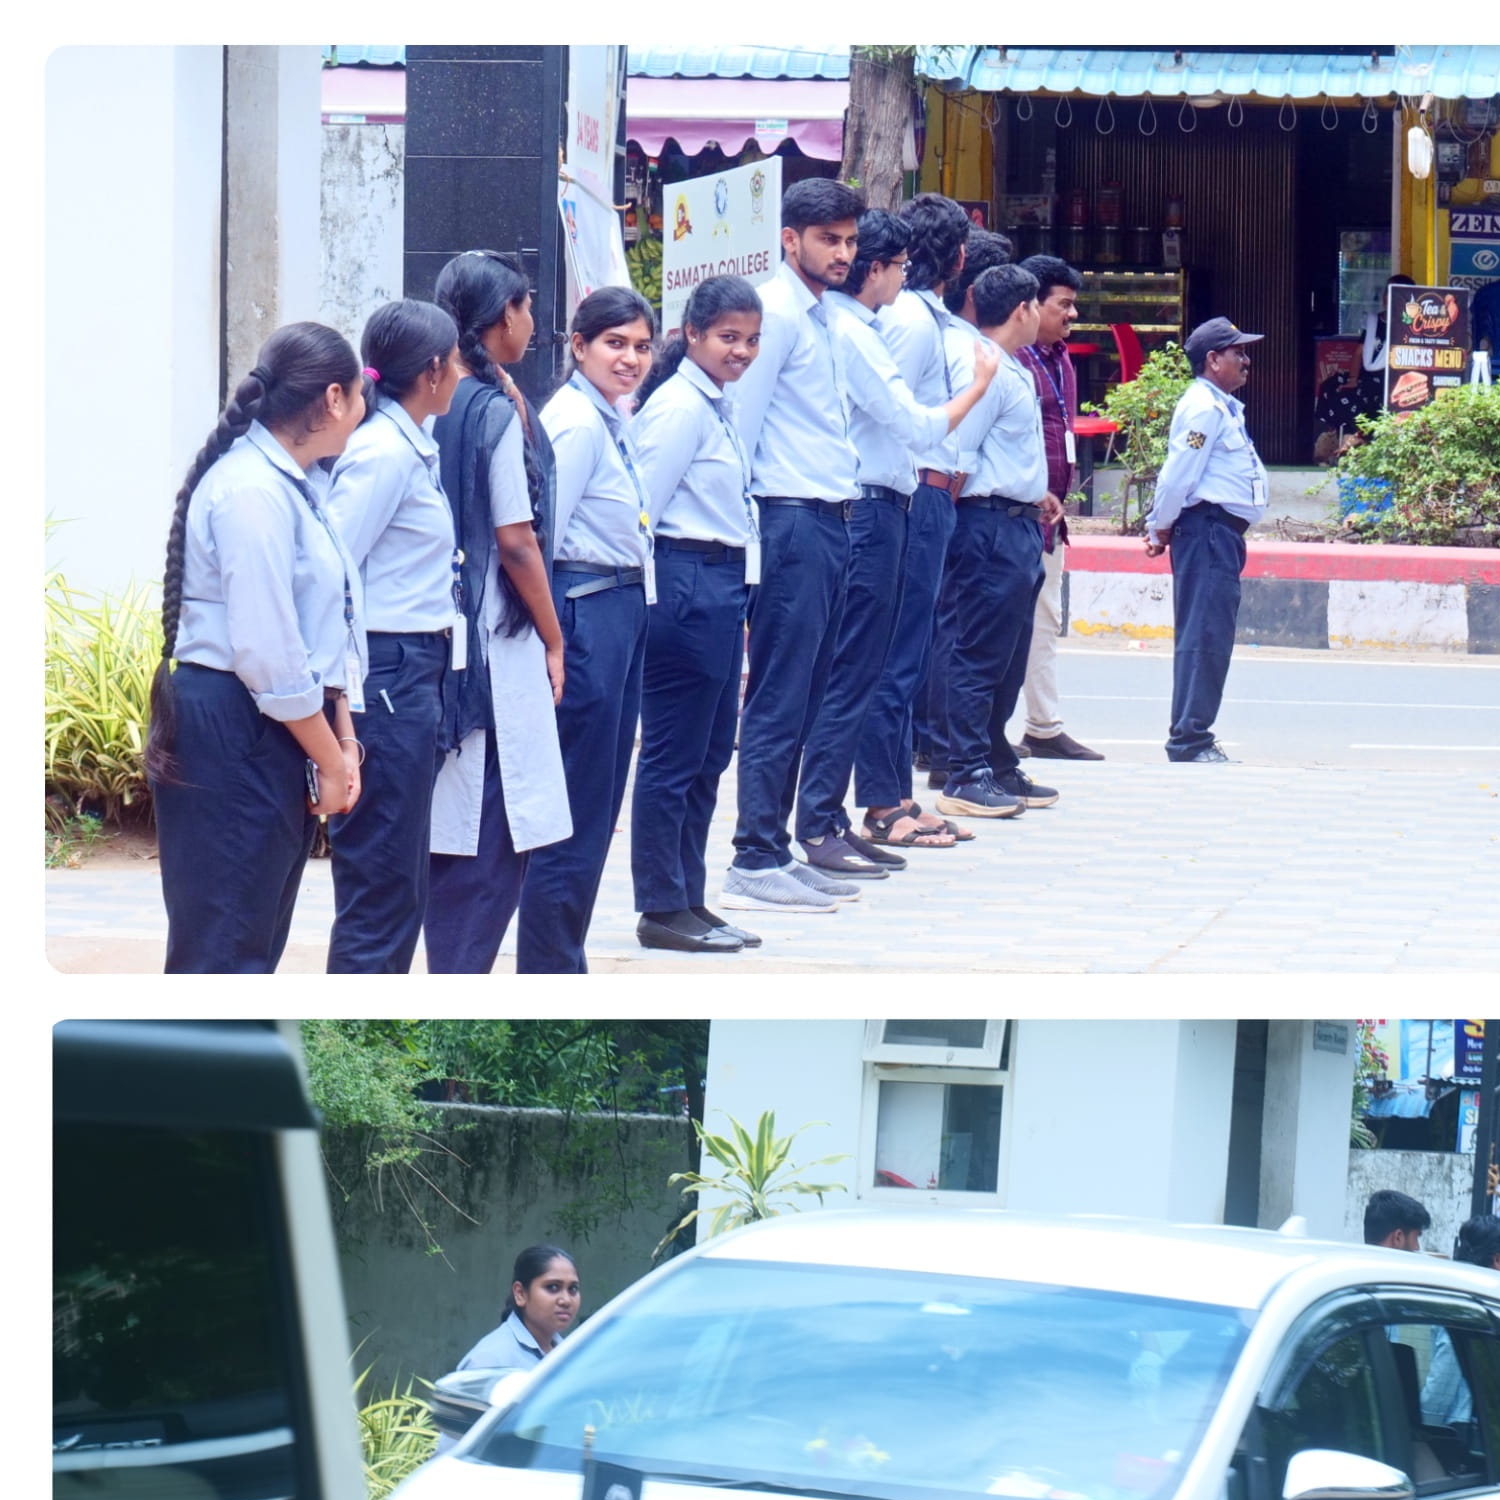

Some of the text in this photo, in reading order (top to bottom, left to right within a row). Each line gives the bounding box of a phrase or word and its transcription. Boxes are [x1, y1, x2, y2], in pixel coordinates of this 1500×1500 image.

[666, 262, 715, 291] SAMATA
[1421, 300, 1438, 316] Tea
[1412, 315, 1451, 334] Crispy
[1395, 347, 1462, 369] SNACKS MENU
